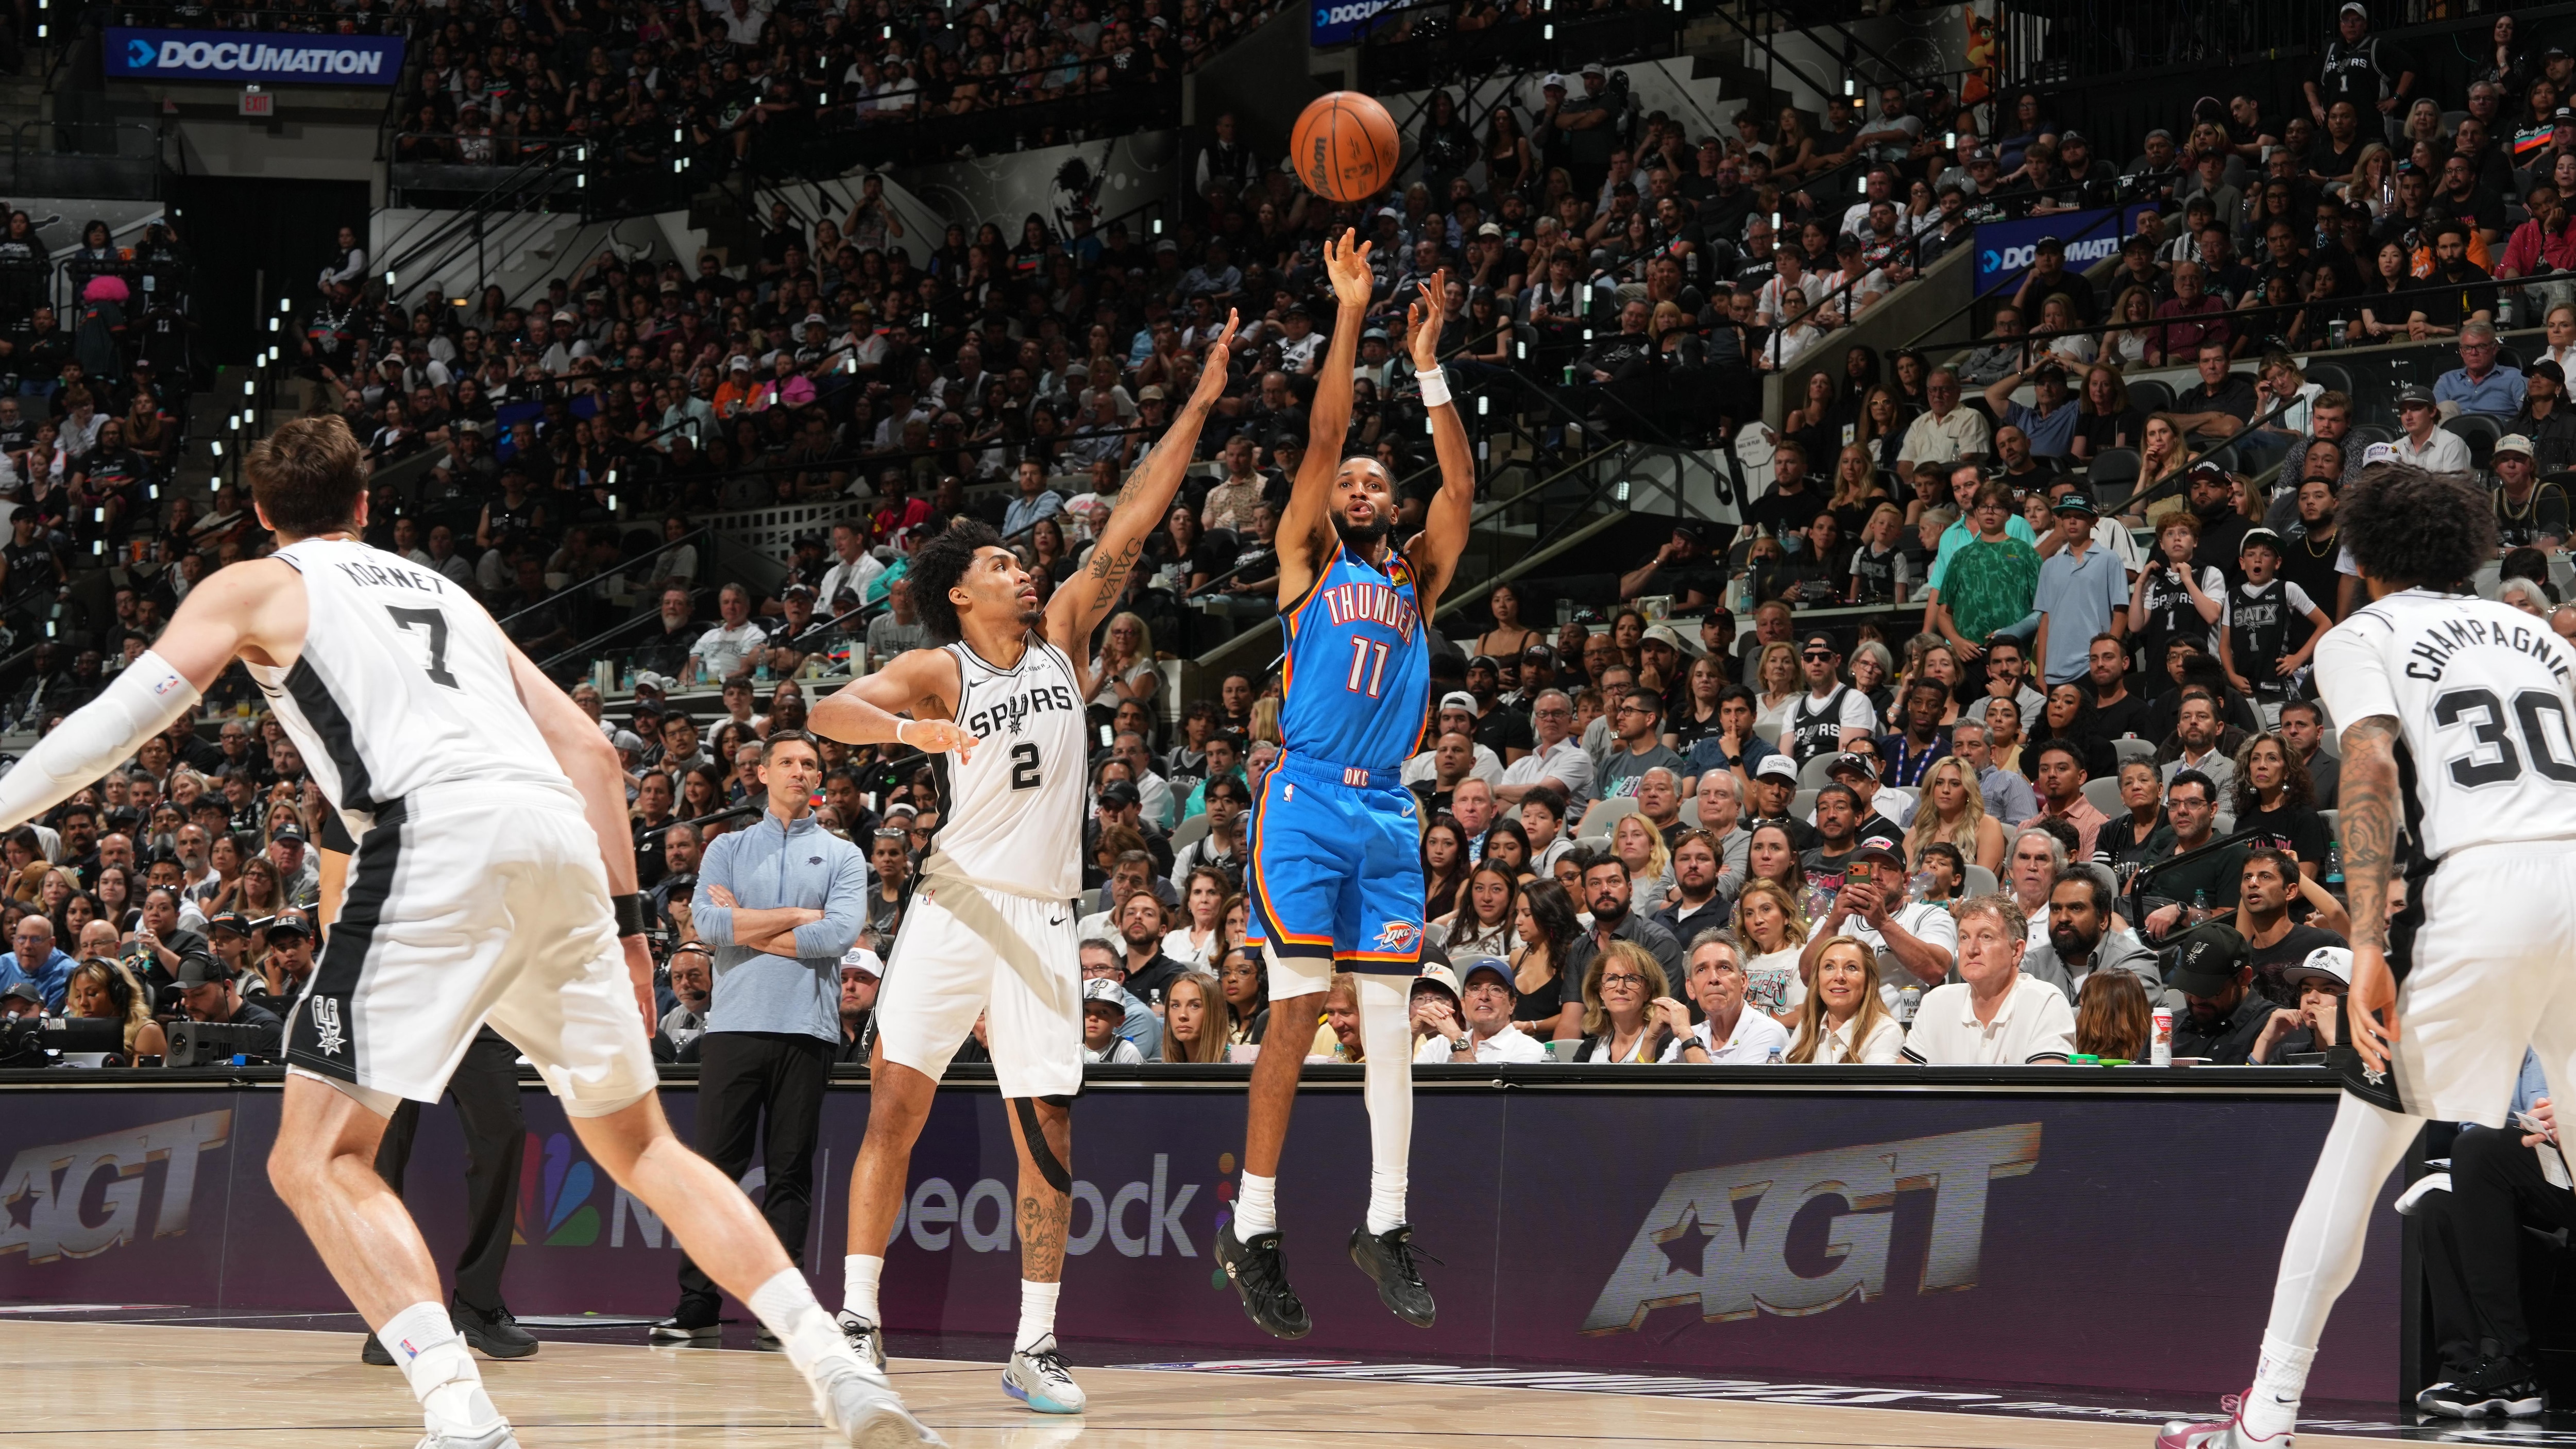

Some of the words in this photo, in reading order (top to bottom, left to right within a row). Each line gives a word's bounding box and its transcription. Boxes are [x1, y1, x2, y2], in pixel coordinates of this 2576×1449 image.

[157, 40, 383, 75] DOCUMATION
[2339, 74, 2348, 92] 1
[245, 96, 268, 111] EXIT
[1746, 263, 1773, 275] VOTE
[491, 517, 529, 528] SPRS
[334, 563, 444, 595] KORNET
[1323, 583, 1416, 647] THUNDER
[2166, 610, 2176, 631] 1
[2233, 603, 2279, 628] SATX
[384, 605, 461, 690] 7
[884, 640, 916, 651] SPURS
[2249, 632, 2259, 652] 1
[1024, 663, 1046, 673] LEDGER
[1346, 634, 1391, 699] 11
[970, 685, 1073, 740] SPURS
[2432, 688, 2576, 789] 30
[1010, 741, 1042, 792] 2
[1767, 760, 1792, 769] Spurs
[1343, 767, 1370, 787] OKC
[1382, 927, 1411, 945] OKC
[1904, 998, 1921, 1008] Mode
[49, 1018, 66, 1031] NBA
[0, 1109, 232, 1266] AGT
[887, 1153, 1200, 1258] eaock
[1579, 1122, 2043, 1337] AGT
